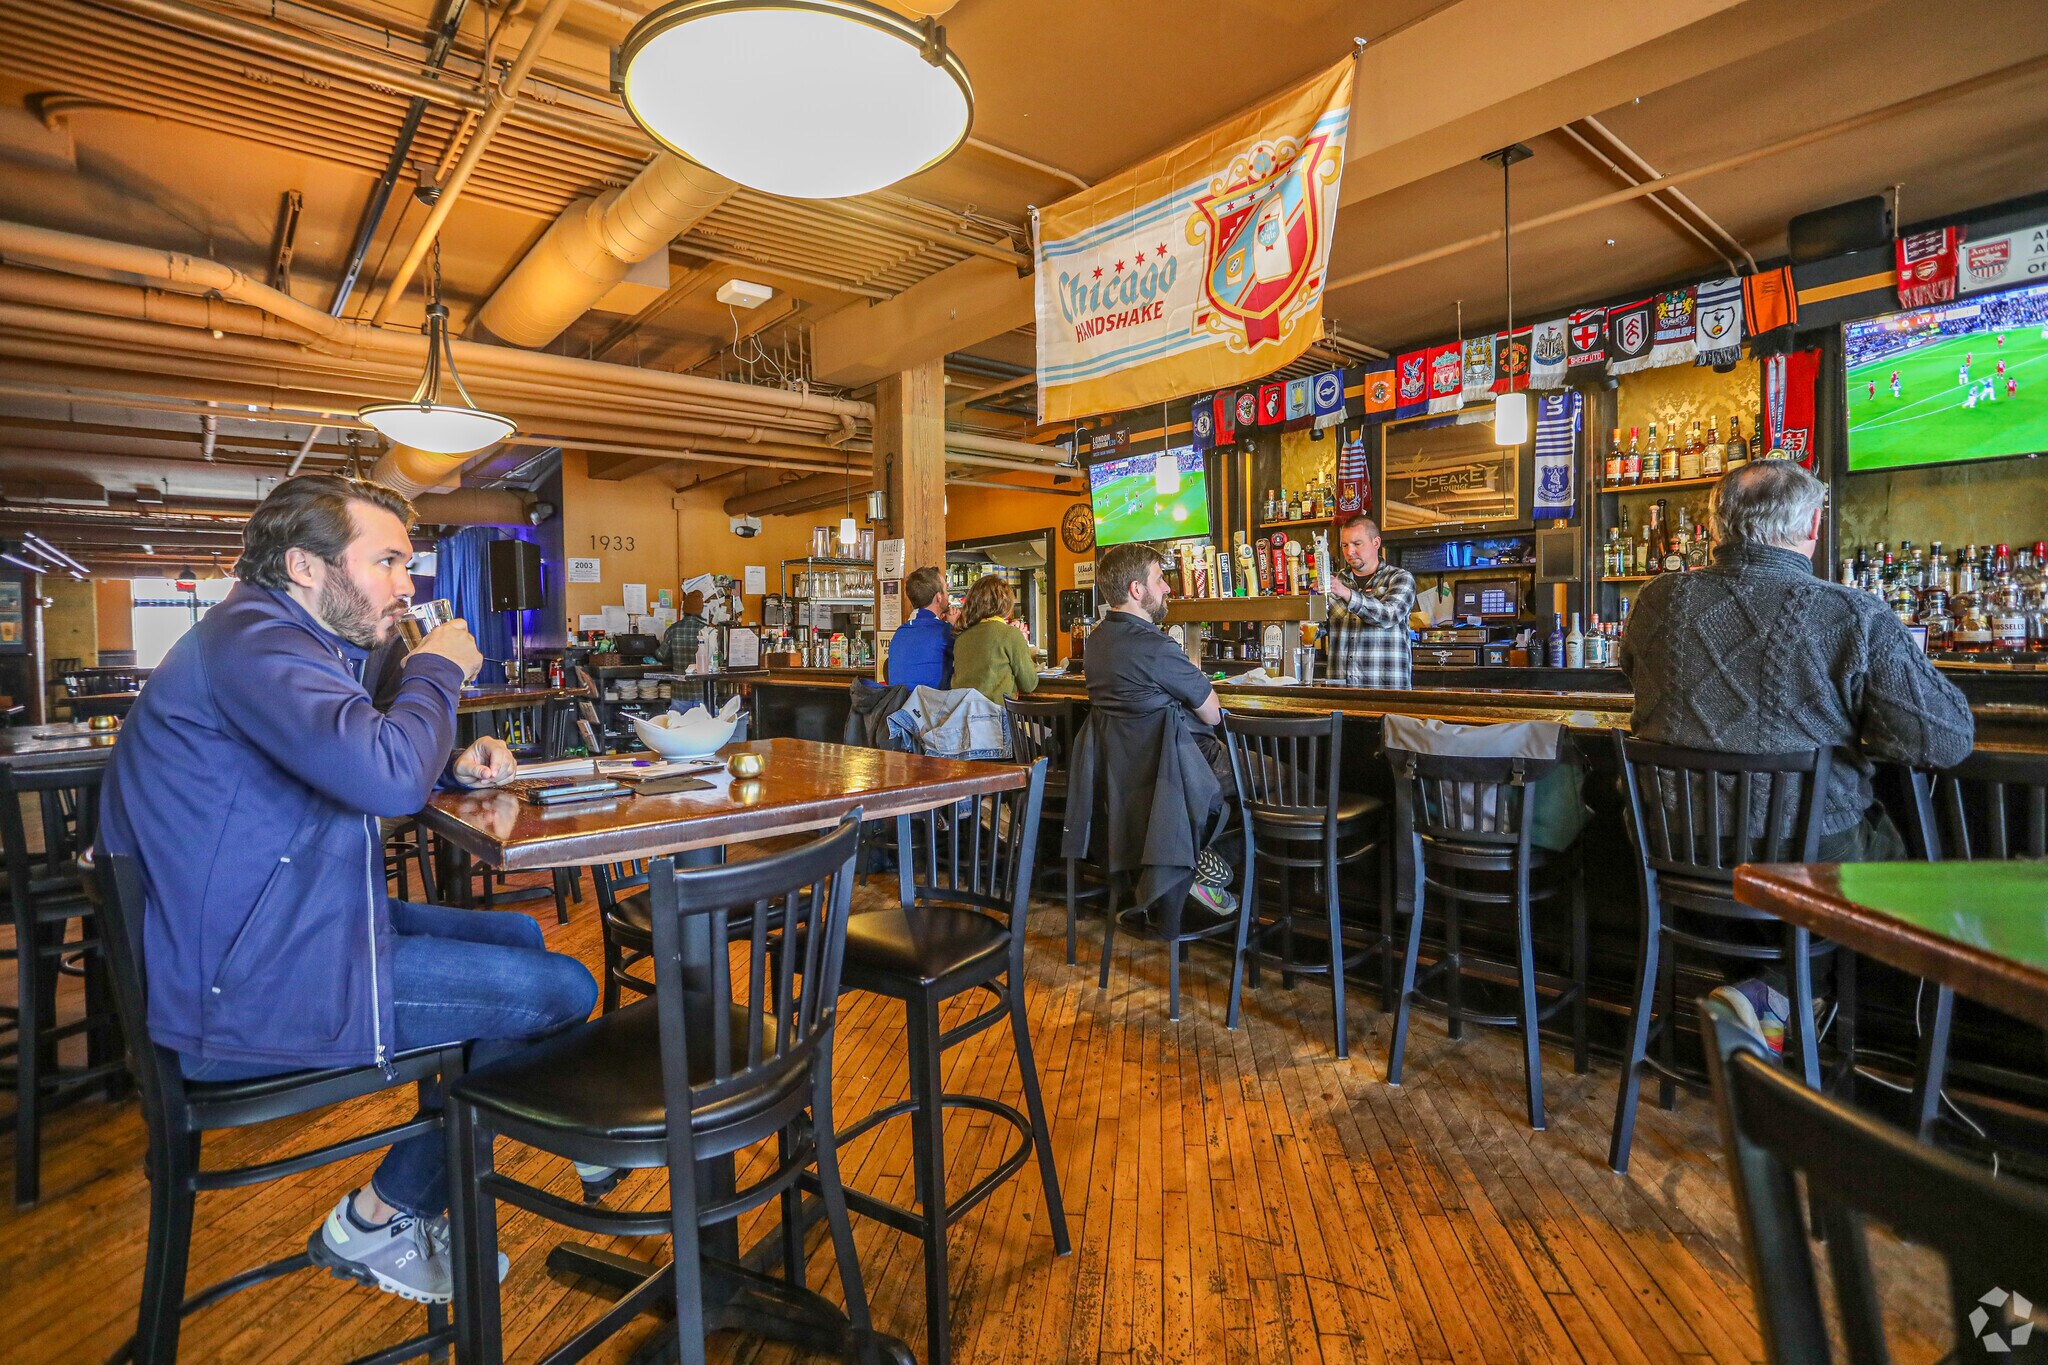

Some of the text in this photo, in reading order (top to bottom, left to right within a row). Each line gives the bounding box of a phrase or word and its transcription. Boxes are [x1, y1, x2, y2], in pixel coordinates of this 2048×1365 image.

[1260, 231, 1276, 244] Style
[1970, 243, 2008, 256] America
[1058, 255, 1178, 324] Chicago
[1076, 300, 1164, 344] HANDSHAKE
[1917, 316, 1931, 325] LIV
[1570, 354, 1589, 364] SHEFF
[1440, 484, 1468, 492] LOUNGE
[590, 534, 635, 551] 1933
